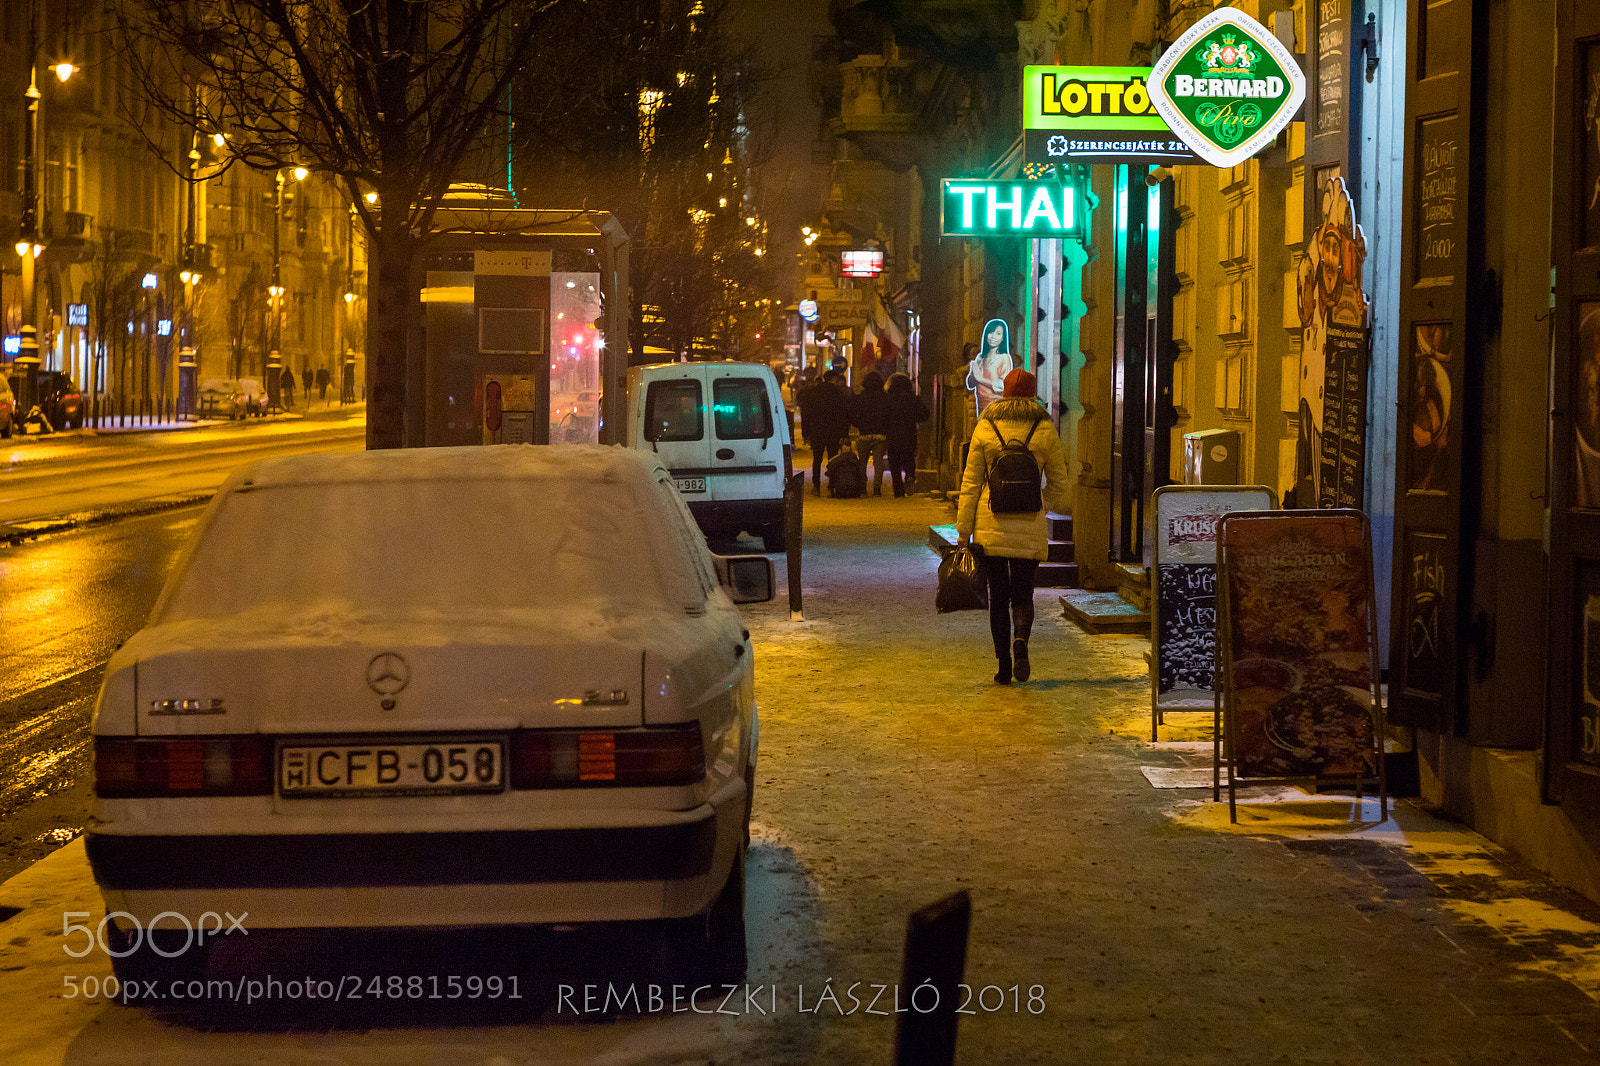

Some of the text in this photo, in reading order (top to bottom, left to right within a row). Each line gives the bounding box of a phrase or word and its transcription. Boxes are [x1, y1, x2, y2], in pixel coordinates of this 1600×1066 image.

[1237, 15, 1299, 78] ORIGINAL CZECH LAGER
[1174, 75, 1284, 98] BERNARD
[1201, 100, 1255, 125] Pivo
[1184, 129, 1211, 153] PIVOVAR
[1244, 134, 1267, 153] FAMILY
[1268, 105, 1294, 135] BREWERY
[1069, 140, 1165, 152] SZERENCSEJÁTÉK
[949, 186, 1074, 229] THAI
[1242, 552, 1346, 567] HUNGARIAN
[1413, 551, 1445, 597] Fish
[316, 747, 495, 786] CFB-058
